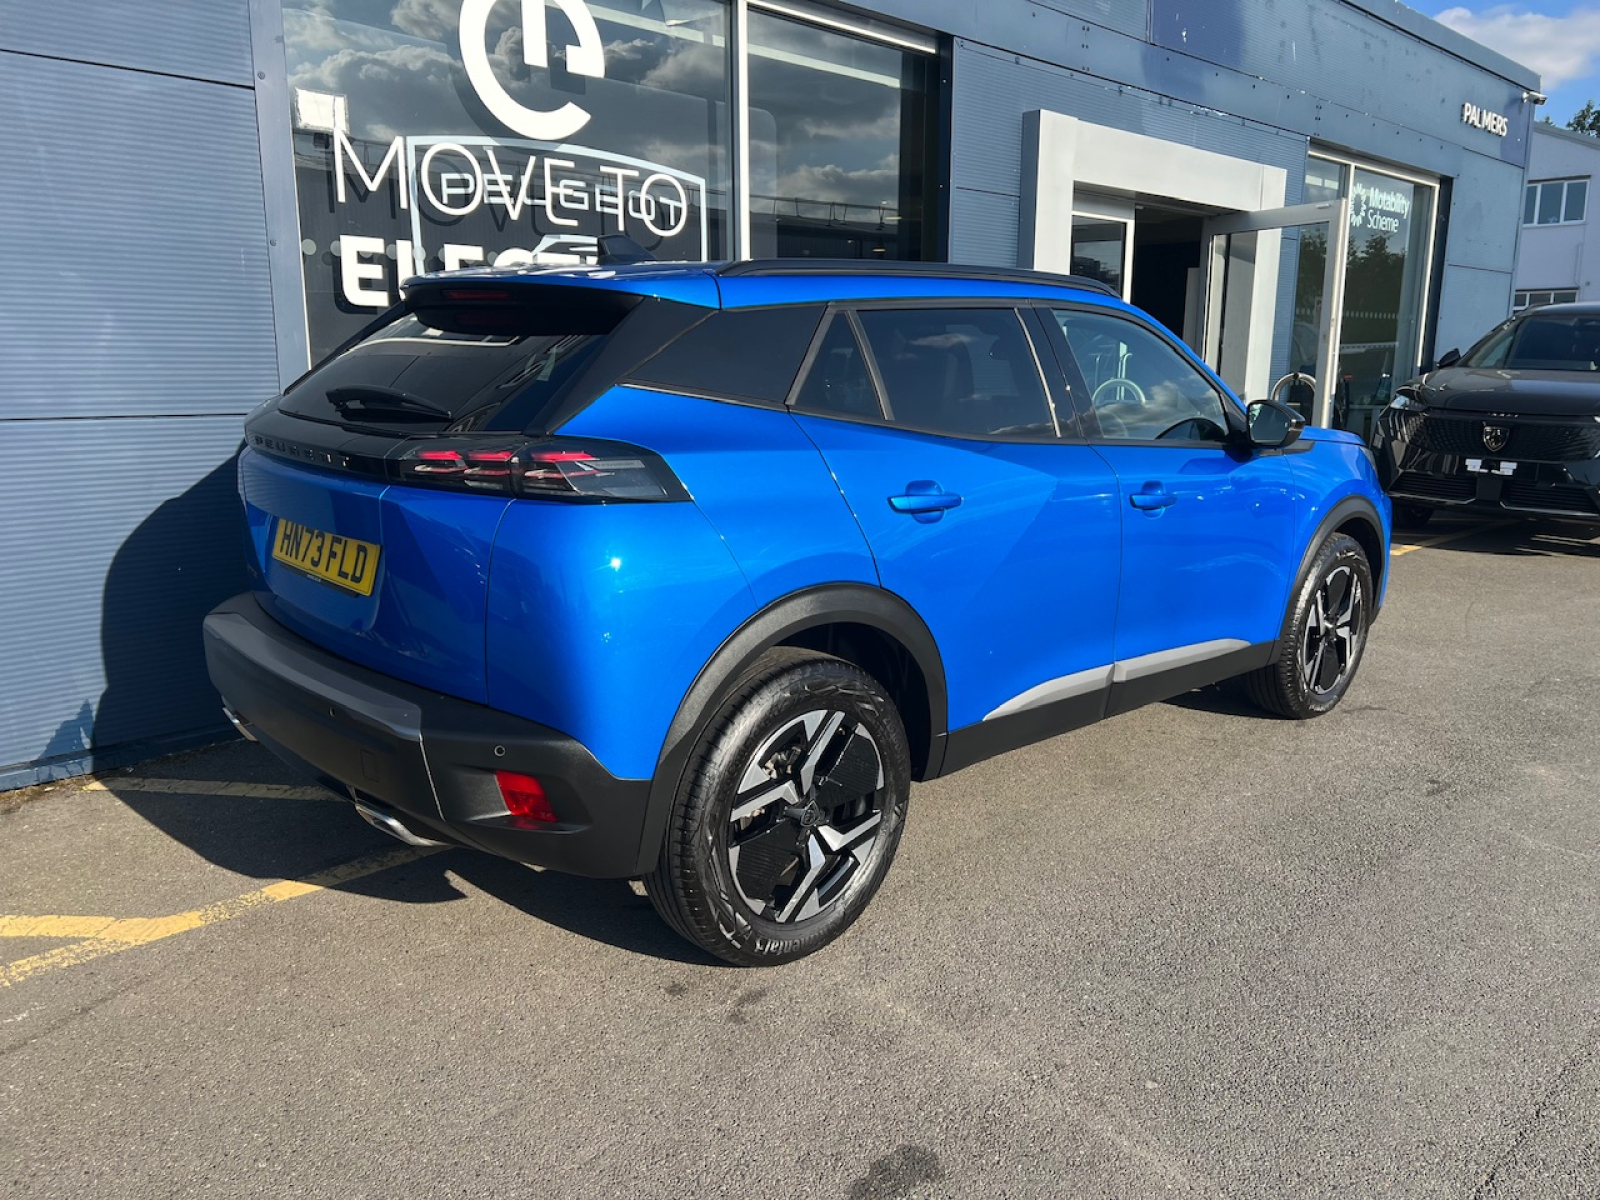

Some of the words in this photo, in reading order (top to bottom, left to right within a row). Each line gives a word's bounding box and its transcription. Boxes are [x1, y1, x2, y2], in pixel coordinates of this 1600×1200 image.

[1463, 101, 1509, 137] PALMERS
[333, 129, 578, 226] MOVE
[600, 165, 688, 237] TO
[1366, 209, 1400, 233] Scheme
[1368, 187, 1411, 219] Motability
[279, 519, 325, 568] HN73
[324, 535, 368, 584] FLD
